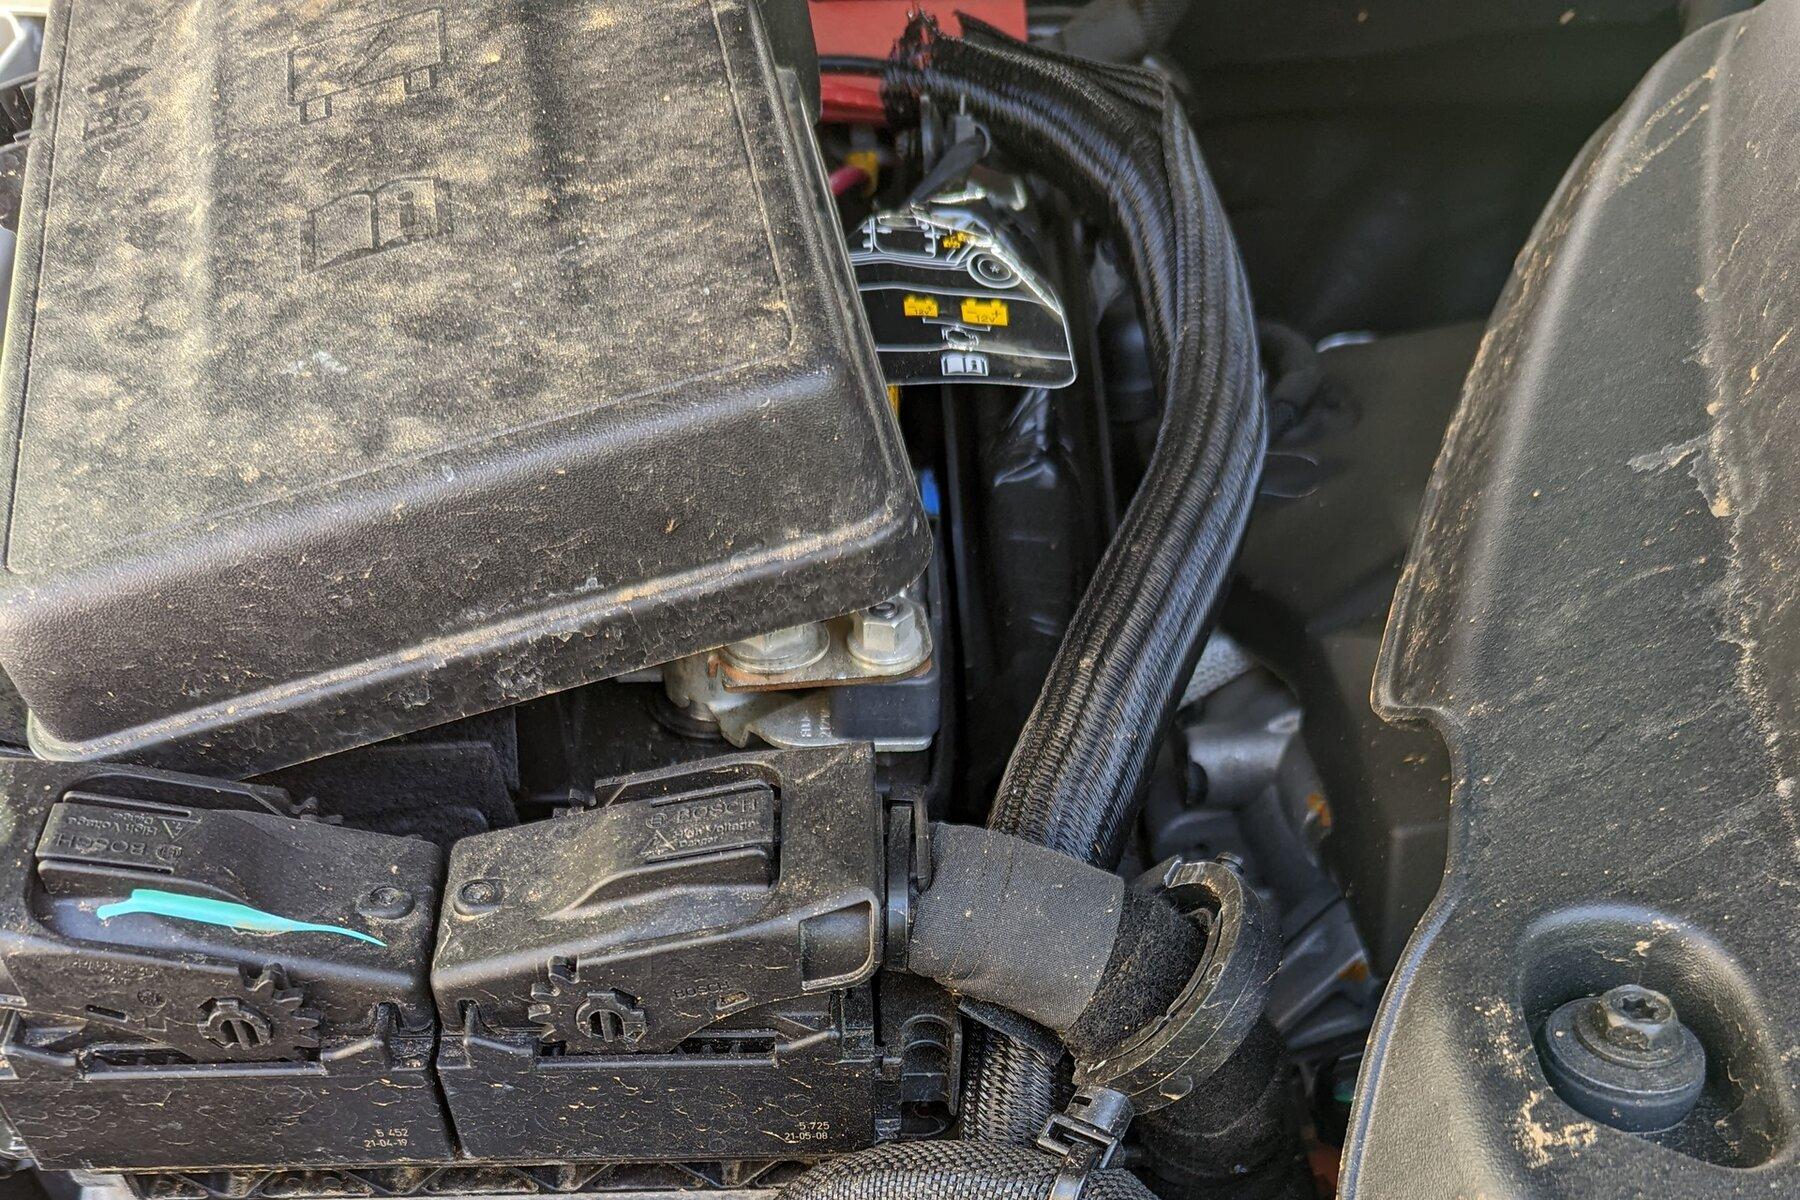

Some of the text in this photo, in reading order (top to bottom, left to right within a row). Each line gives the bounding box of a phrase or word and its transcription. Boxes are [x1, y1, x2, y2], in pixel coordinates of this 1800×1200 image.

[675, 799, 758, 824] BOSCH
[55, 832, 147, 857] BOSCH
[672, 980, 731, 1000] BOSCH
[809, 1121, 830, 1130] 725
[388, 1128, 409, 1137] 452
[784, 1131, 828, 1140] 21-05-08
[363, 1139, 408, 1148] 21-04-19
